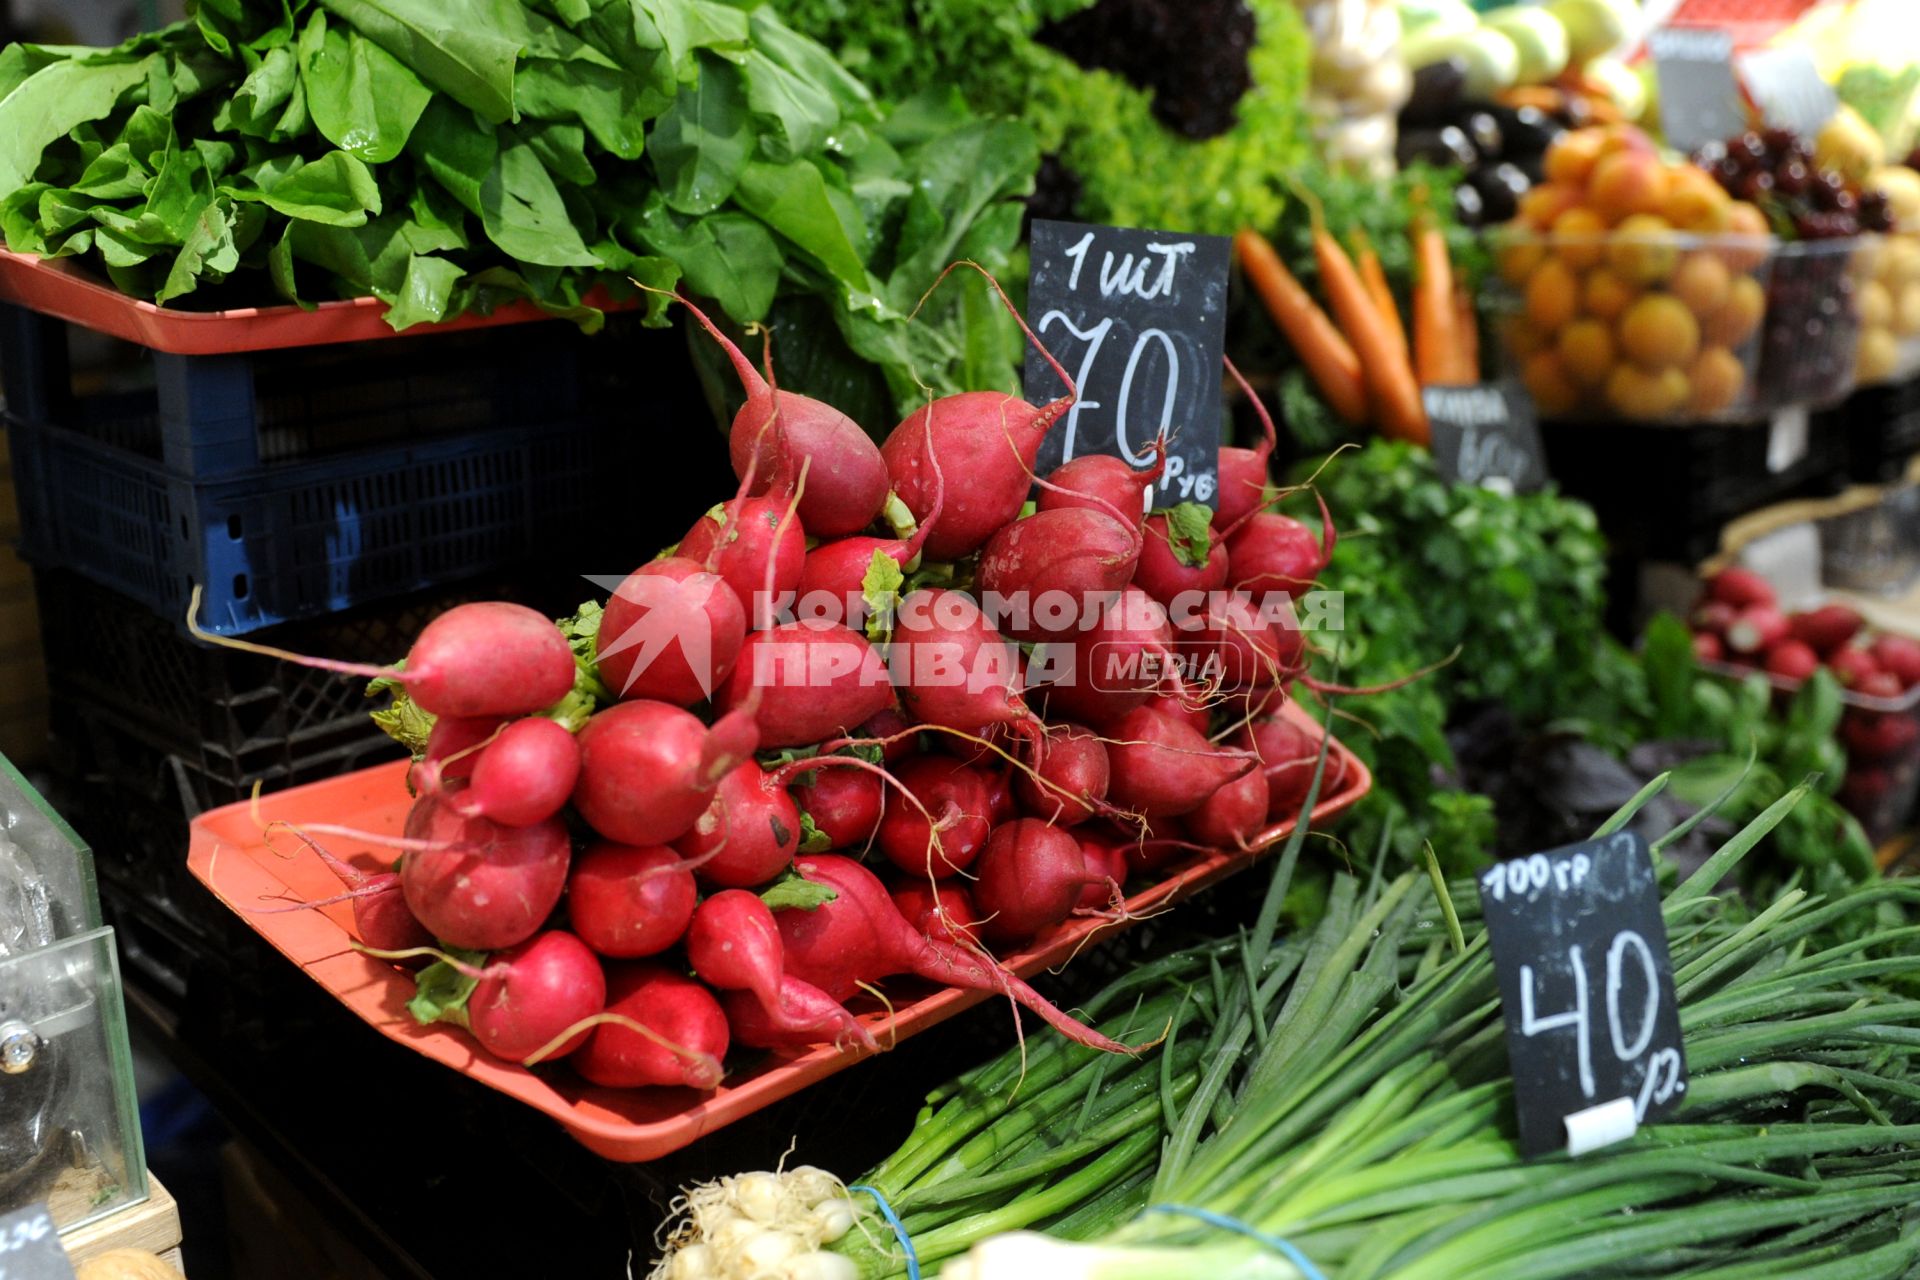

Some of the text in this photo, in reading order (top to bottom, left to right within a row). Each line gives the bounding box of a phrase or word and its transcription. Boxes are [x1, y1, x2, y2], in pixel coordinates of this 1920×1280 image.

[1064, 232, 1196, 300] 1 шт
[1038, 310, 1180, 467] 70
[1520, 930, 1660, 1098] 40
